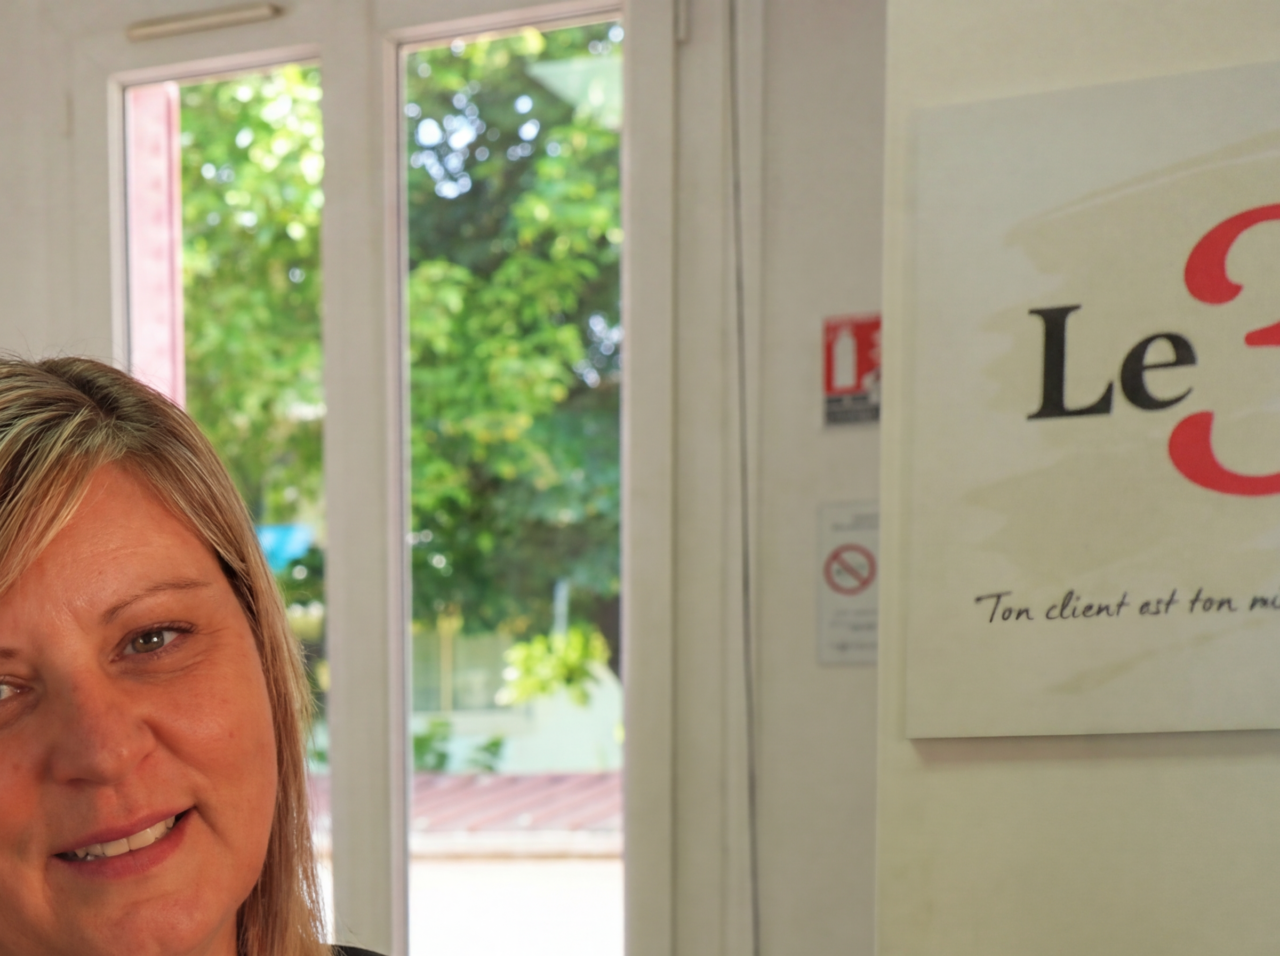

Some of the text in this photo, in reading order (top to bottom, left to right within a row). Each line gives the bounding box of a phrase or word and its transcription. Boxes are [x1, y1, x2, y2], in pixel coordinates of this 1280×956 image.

[1027, 304, 1198, 421] Le
[974, 591, 1034, 624] Ton
[1045, 589, 1130, 620] client
[1138, 588, 1179, 616] est
[1189, 587, 1238, 613] ton
